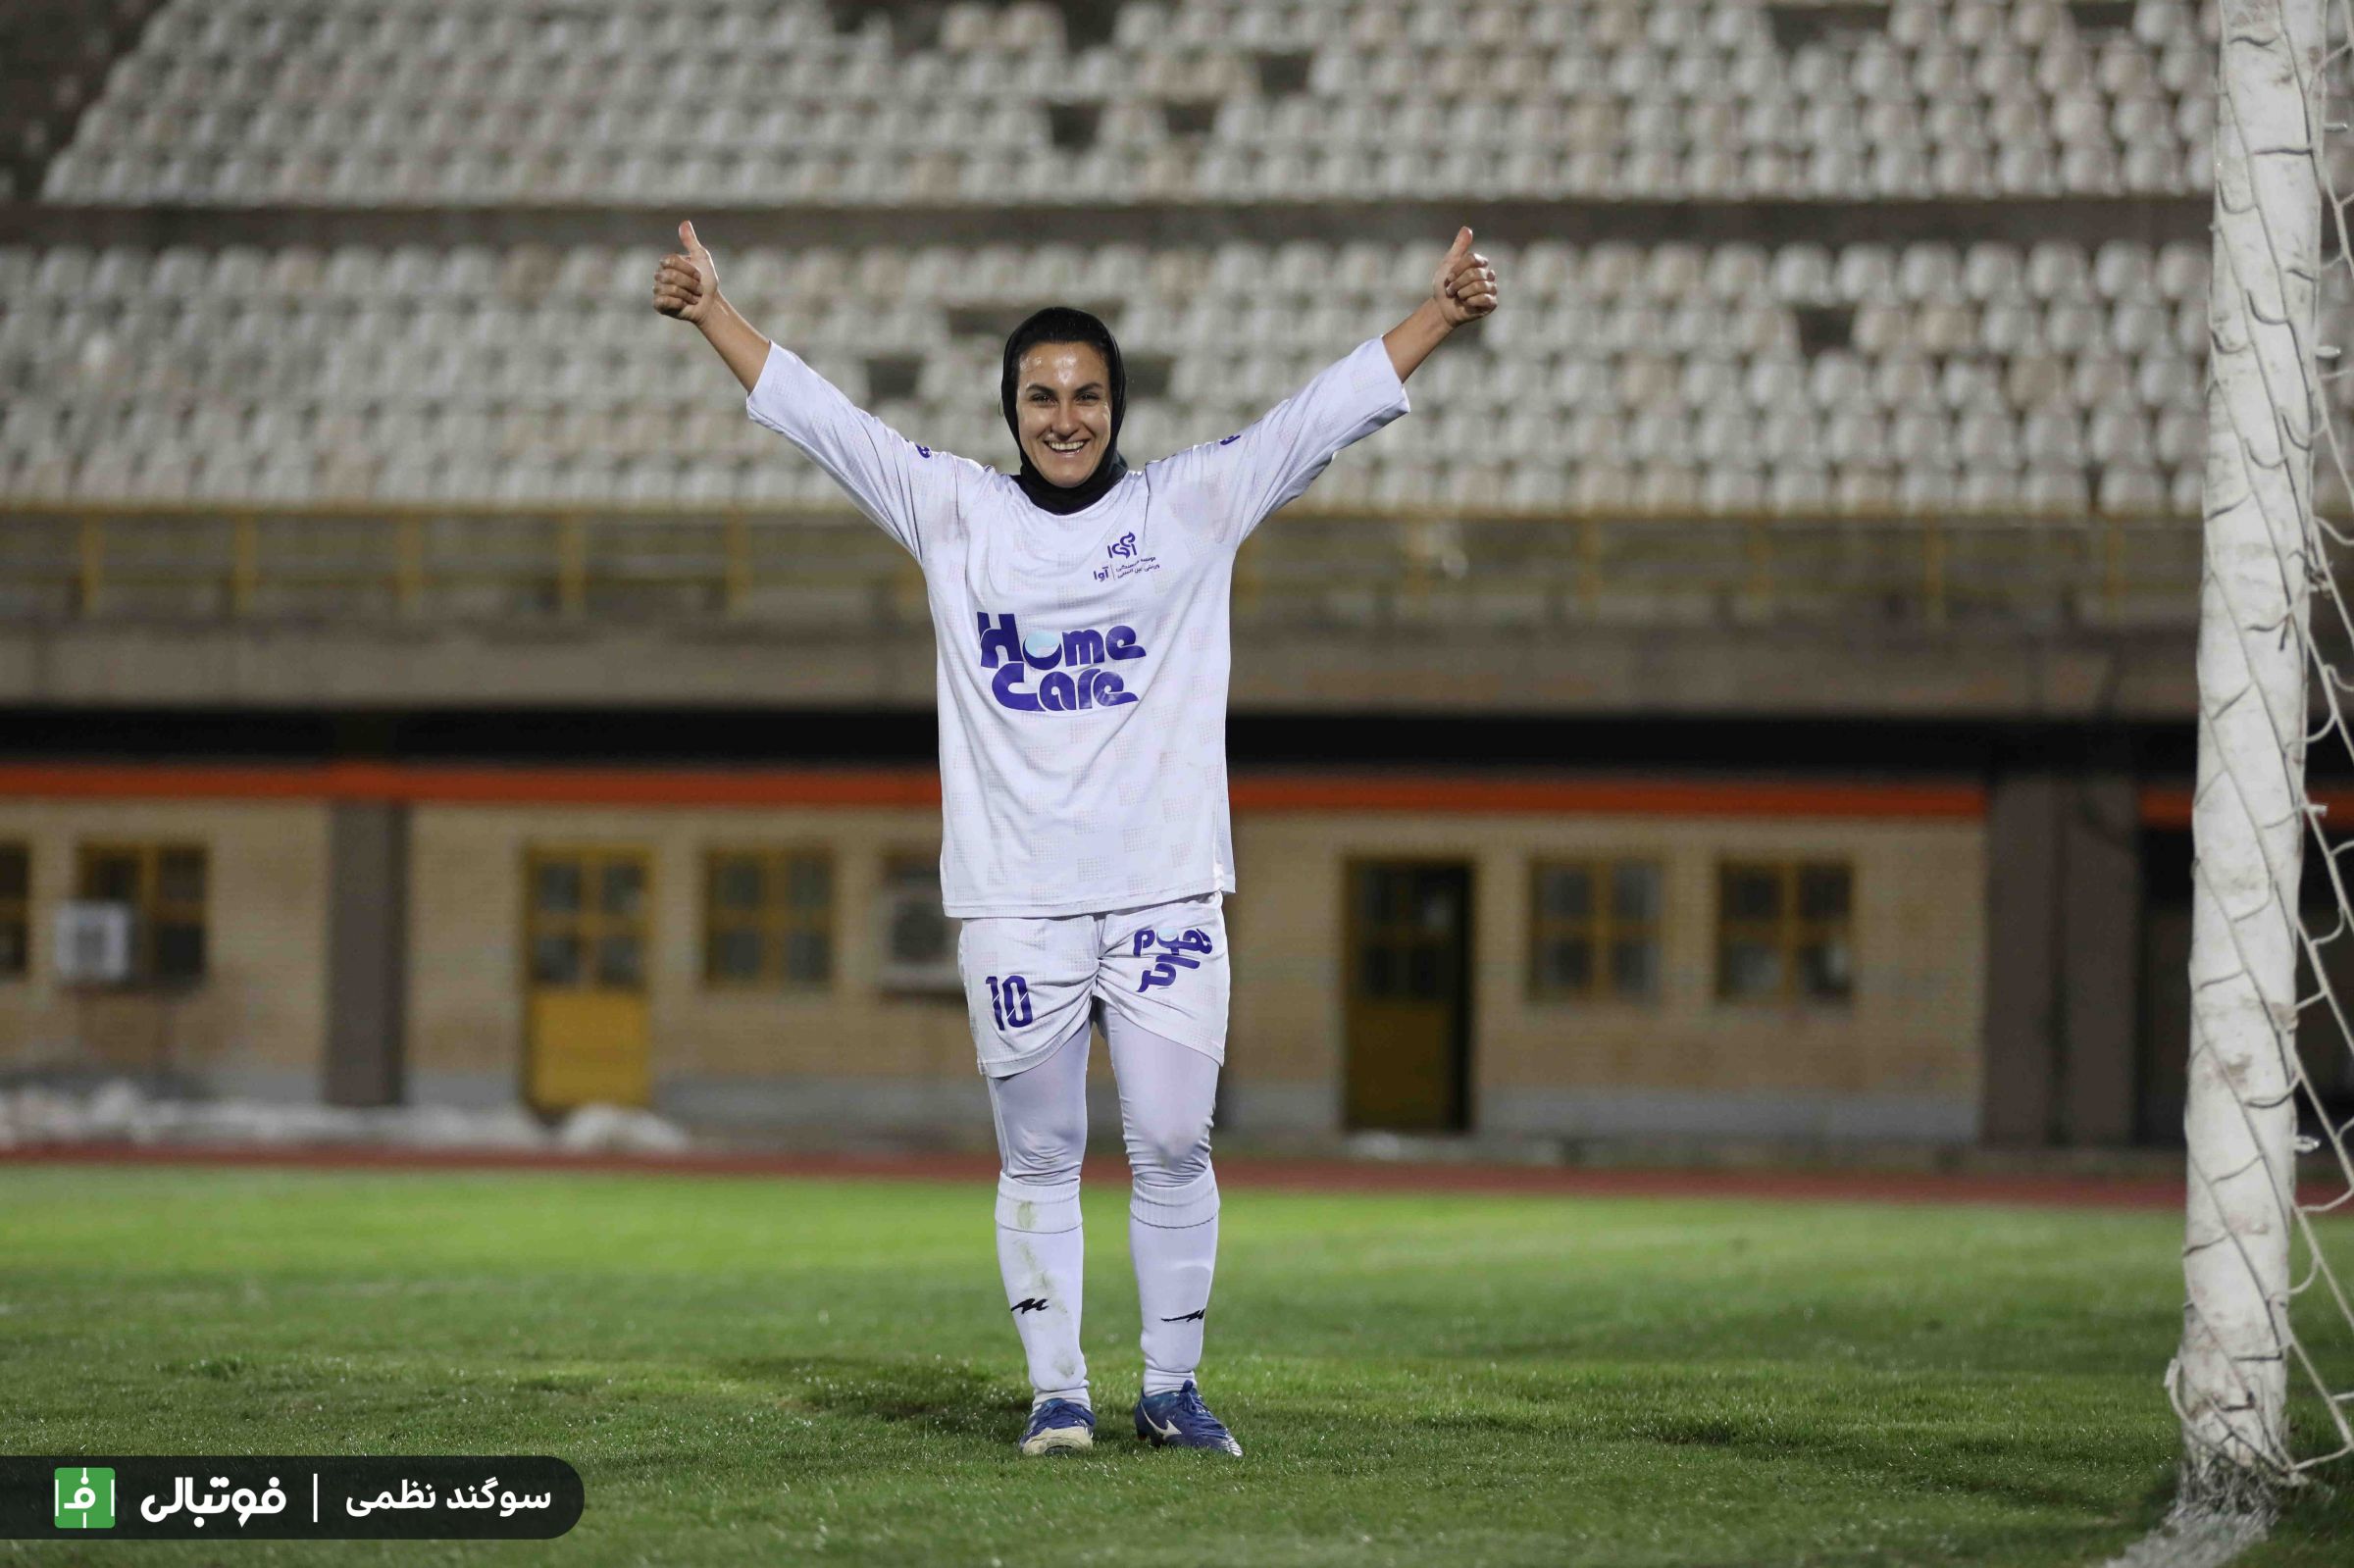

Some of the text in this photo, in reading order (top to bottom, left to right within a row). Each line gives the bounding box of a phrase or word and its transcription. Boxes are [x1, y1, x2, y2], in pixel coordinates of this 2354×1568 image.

[1093, 566, 1109, 582] آوا
[977, 611, 1147, 671] Home
[992, 662, 1140, 712] Care
[985, 975, 1034, 1031] 10
